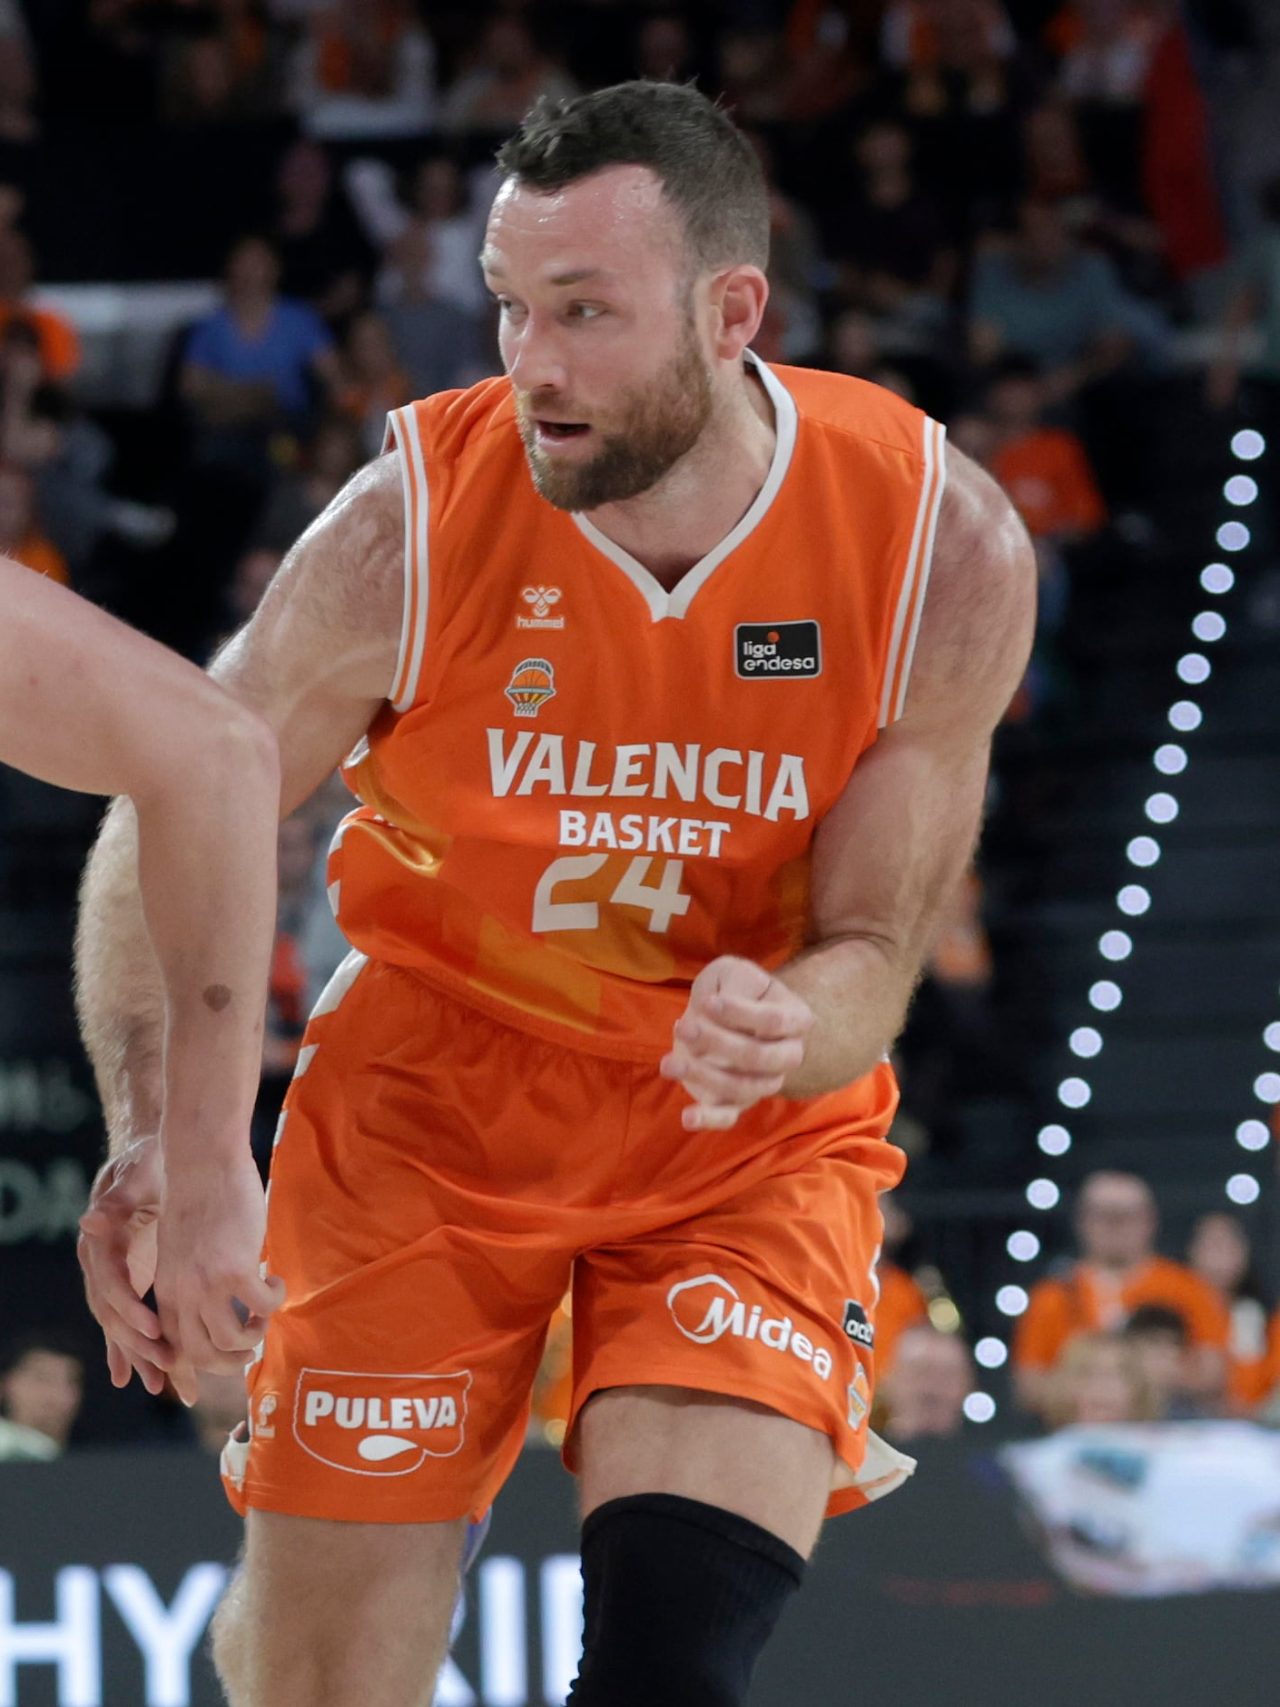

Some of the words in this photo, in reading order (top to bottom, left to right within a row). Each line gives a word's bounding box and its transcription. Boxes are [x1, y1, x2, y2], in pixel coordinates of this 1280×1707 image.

[743, 641, 777, 658] liga
[743, 656, 815, 671] endesa
[486, 727, 810, 822] VALENCIA
[558, 809, 731, 858] BASKET
[531, 852, 692, 933] 24
[694, 1296, 833, 1381] Midea
[304, 1390, 458, 1429] PULEVA
